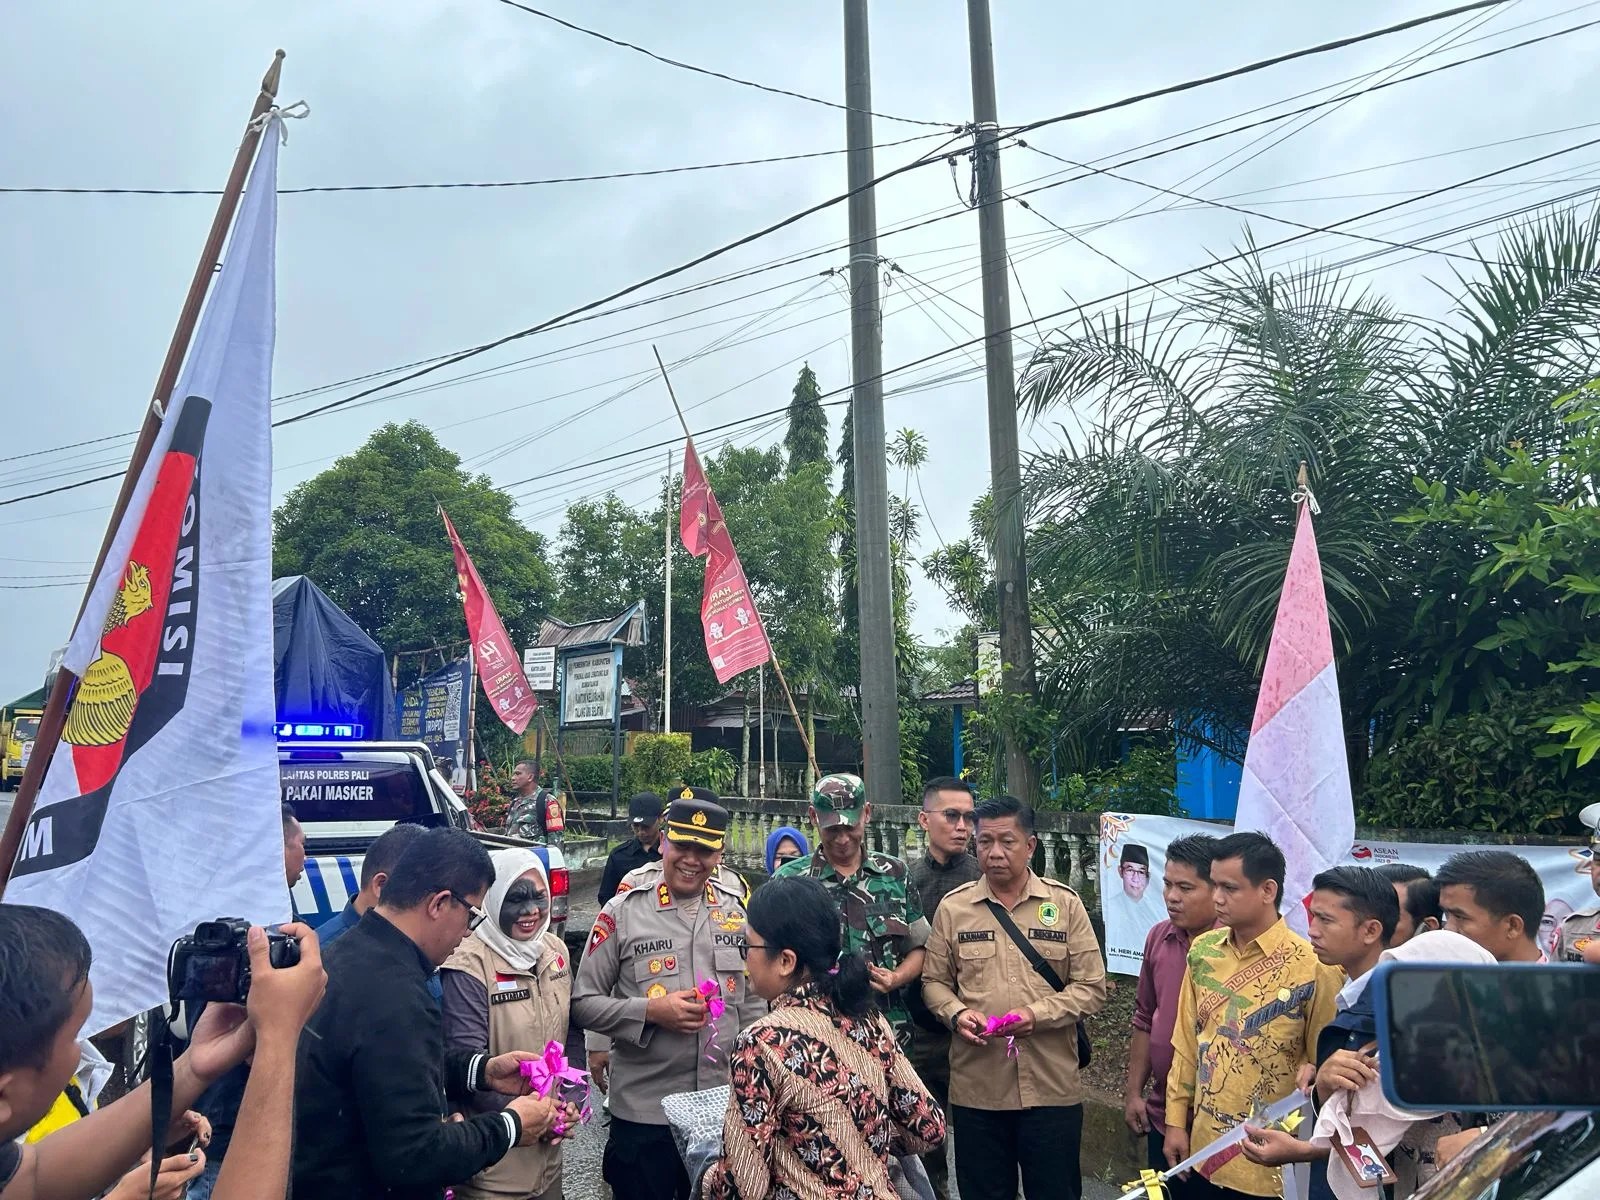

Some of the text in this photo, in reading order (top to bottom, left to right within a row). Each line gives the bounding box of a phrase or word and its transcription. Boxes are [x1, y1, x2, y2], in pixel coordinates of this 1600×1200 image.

[157, 460, 199, 675] OMISI
[316, 770, 347, 780] POLRES
[351, 770, 369, 780] PALI
[286, 786, 374, 801] PAKAI MASKER
[634, 939, 673, 955] KHAIRU
